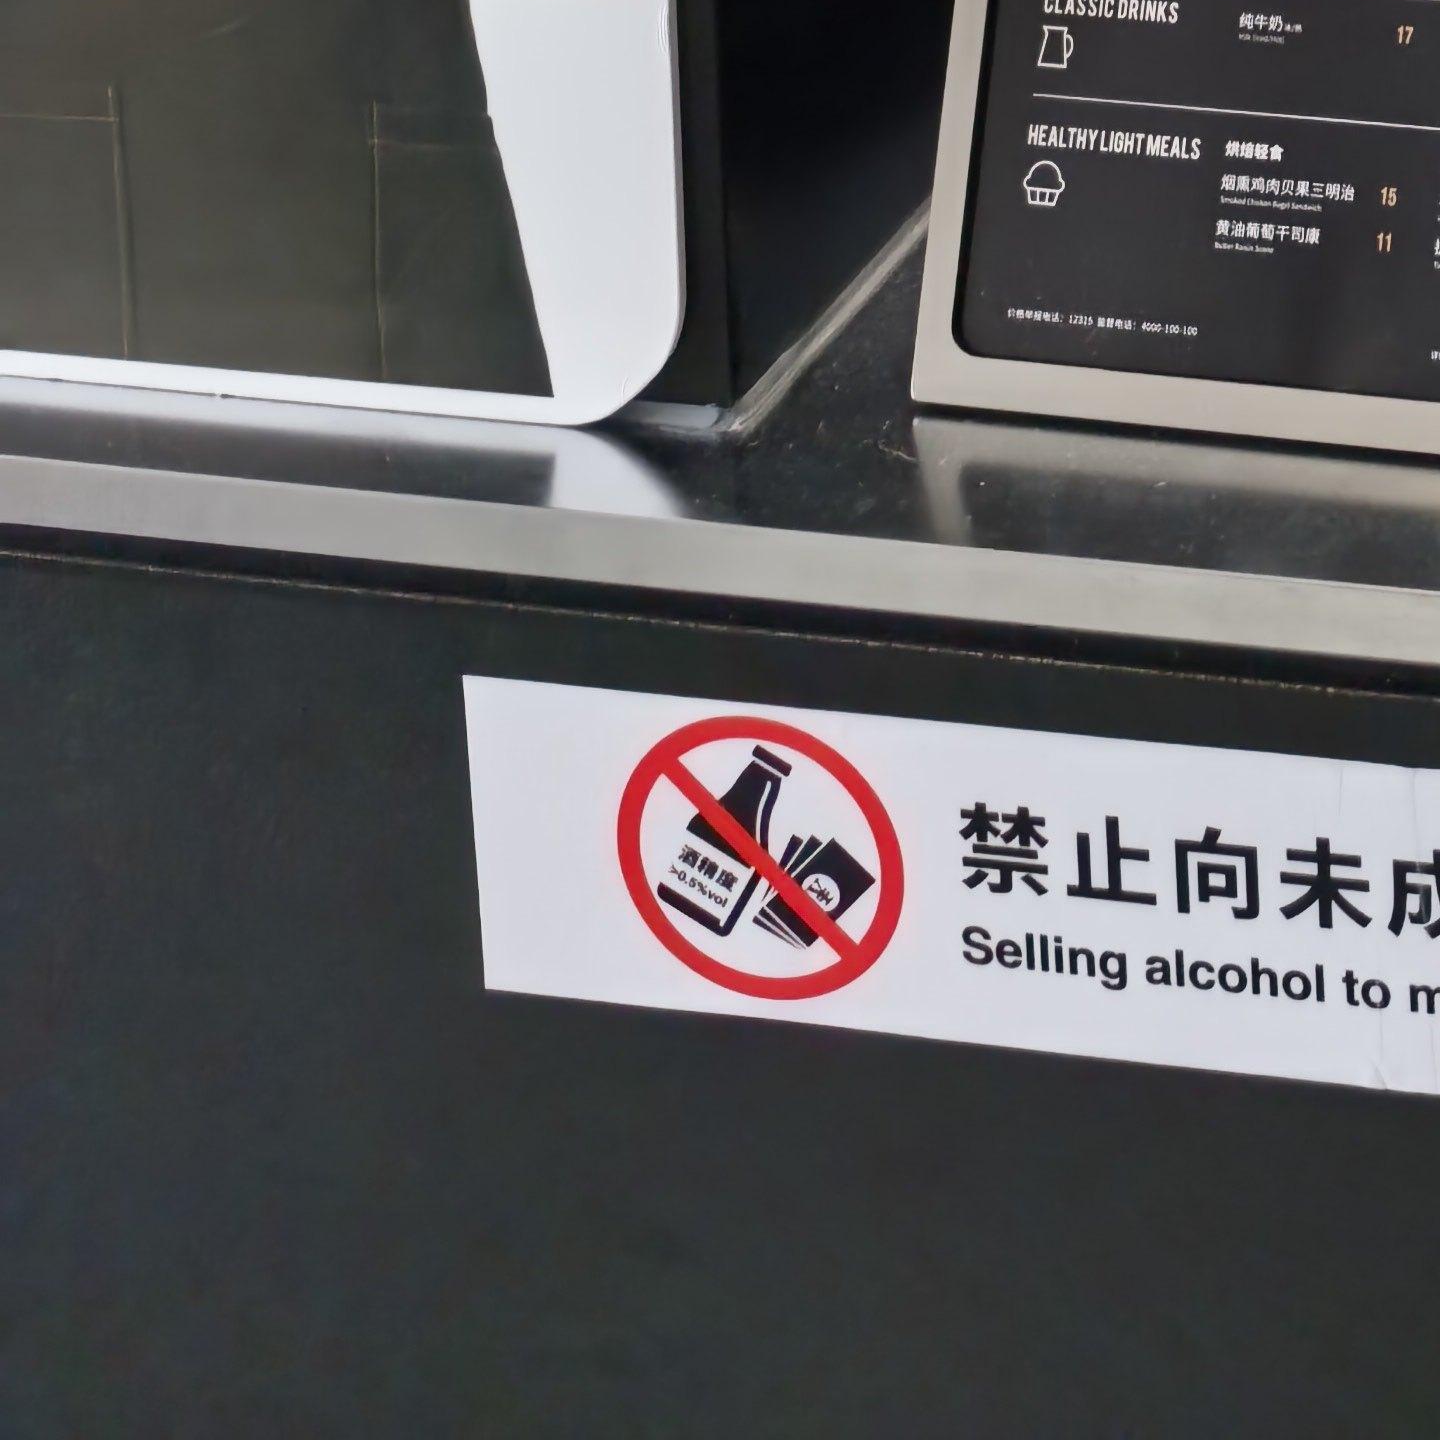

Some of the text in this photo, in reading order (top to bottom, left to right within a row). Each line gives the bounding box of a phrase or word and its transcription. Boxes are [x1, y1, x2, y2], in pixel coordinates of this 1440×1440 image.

[1396, 25, 1415, 46] 17
[1027, 124, 1201, 161] HEALTHY LIGHT MEALS
[1380, 185, 1398, 208] 15
[1376, 231, 1393, 254] 11
[677, 843, 740, 894] 酒精度
[960, 924, 1129, 992] Selling
[1143, 948, 1327, 1006] alcohol
[1340, 965, 1393, 1014] to
